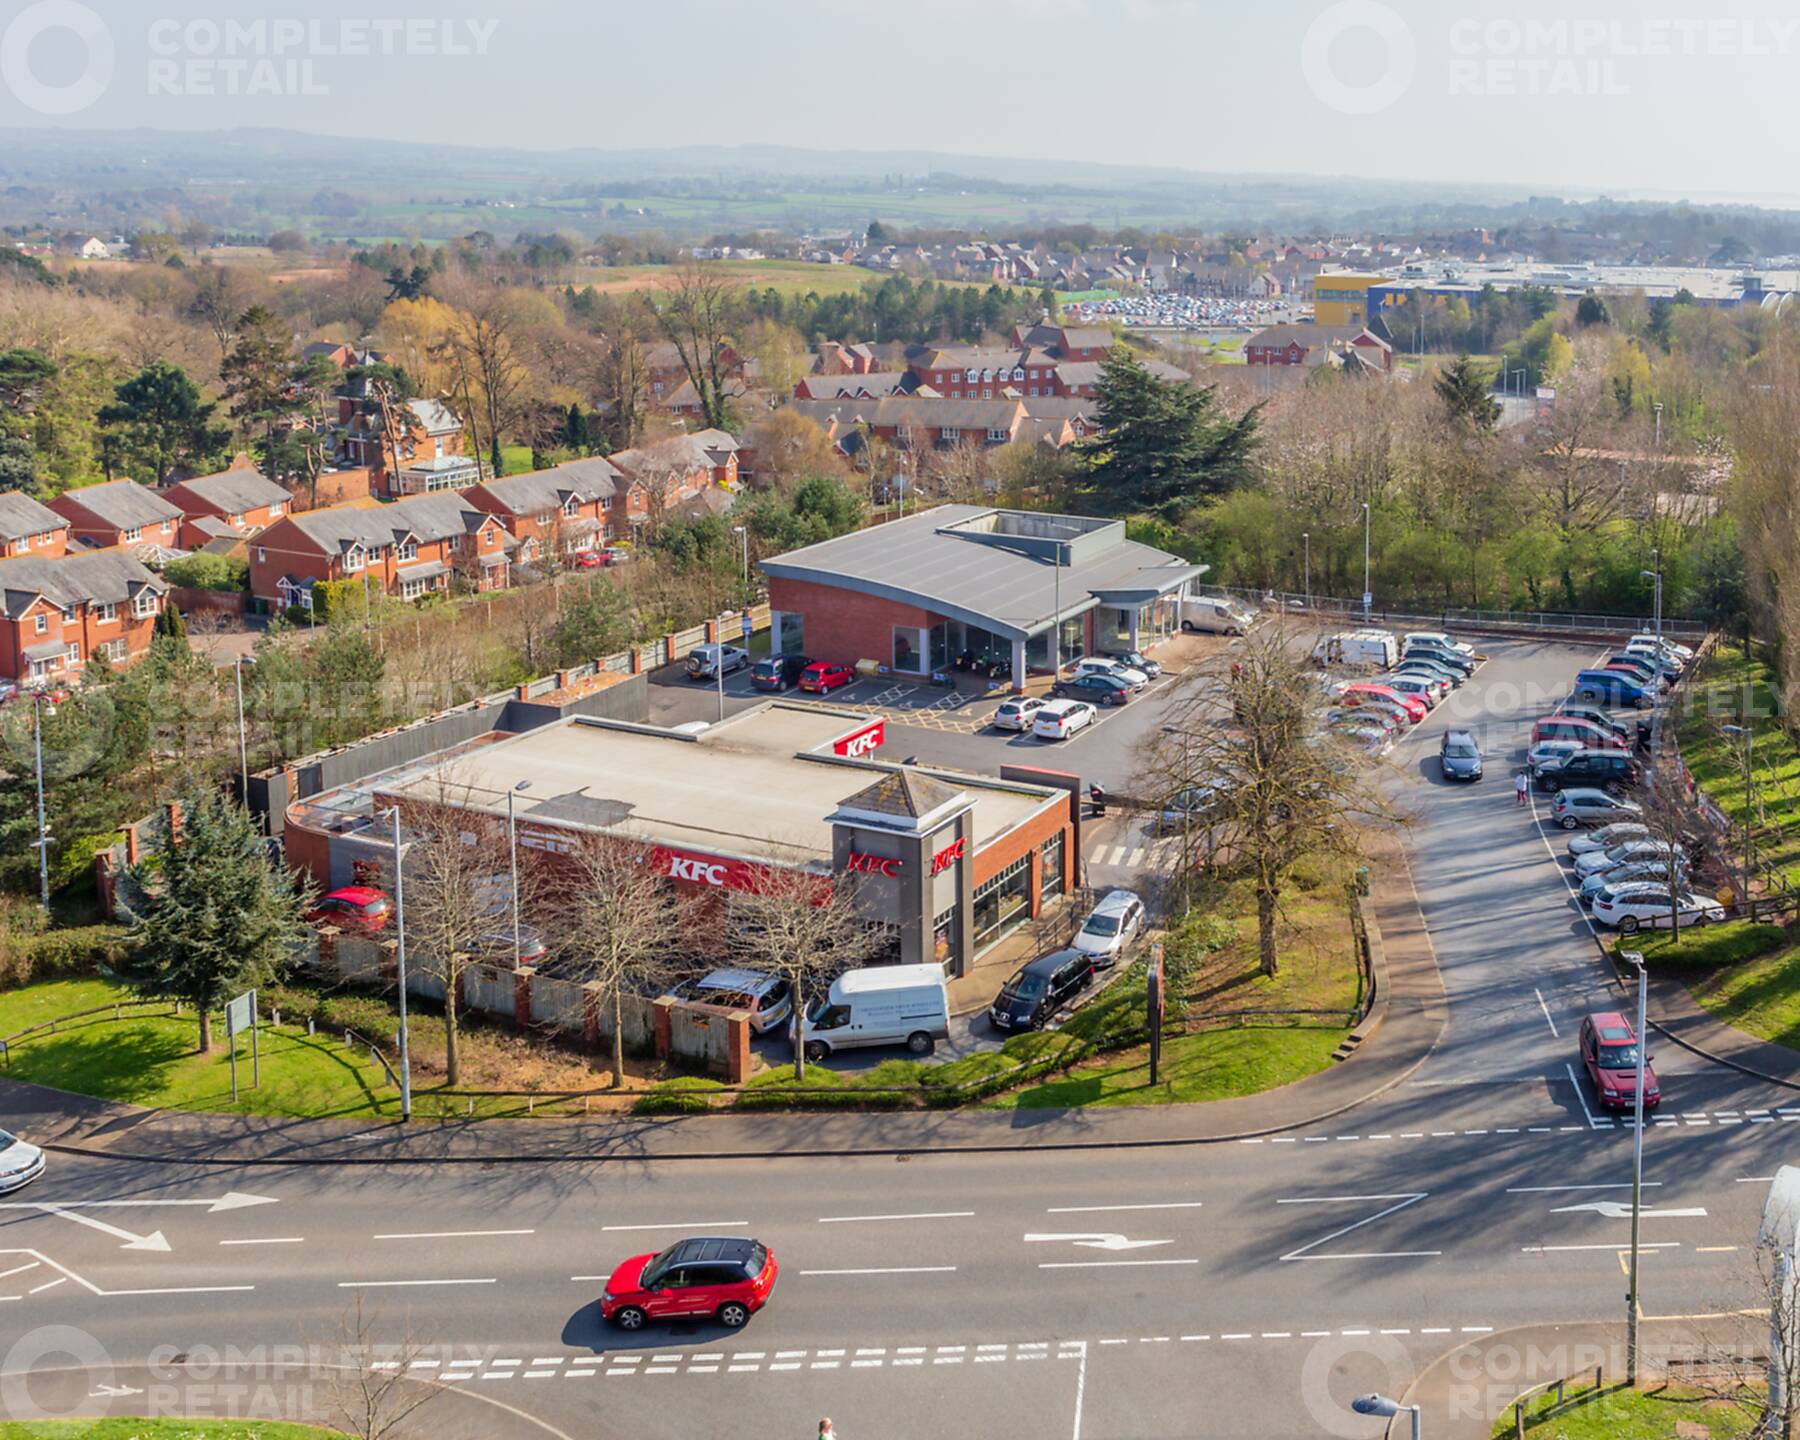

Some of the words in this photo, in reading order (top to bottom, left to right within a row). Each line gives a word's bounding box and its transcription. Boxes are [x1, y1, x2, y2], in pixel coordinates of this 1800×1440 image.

[846, 729, 880, 757] KFC
[847, 851, 902, 878] KFC
[931, 837, 967, 875] KFC
[669, 856, 727, 885] KFC
